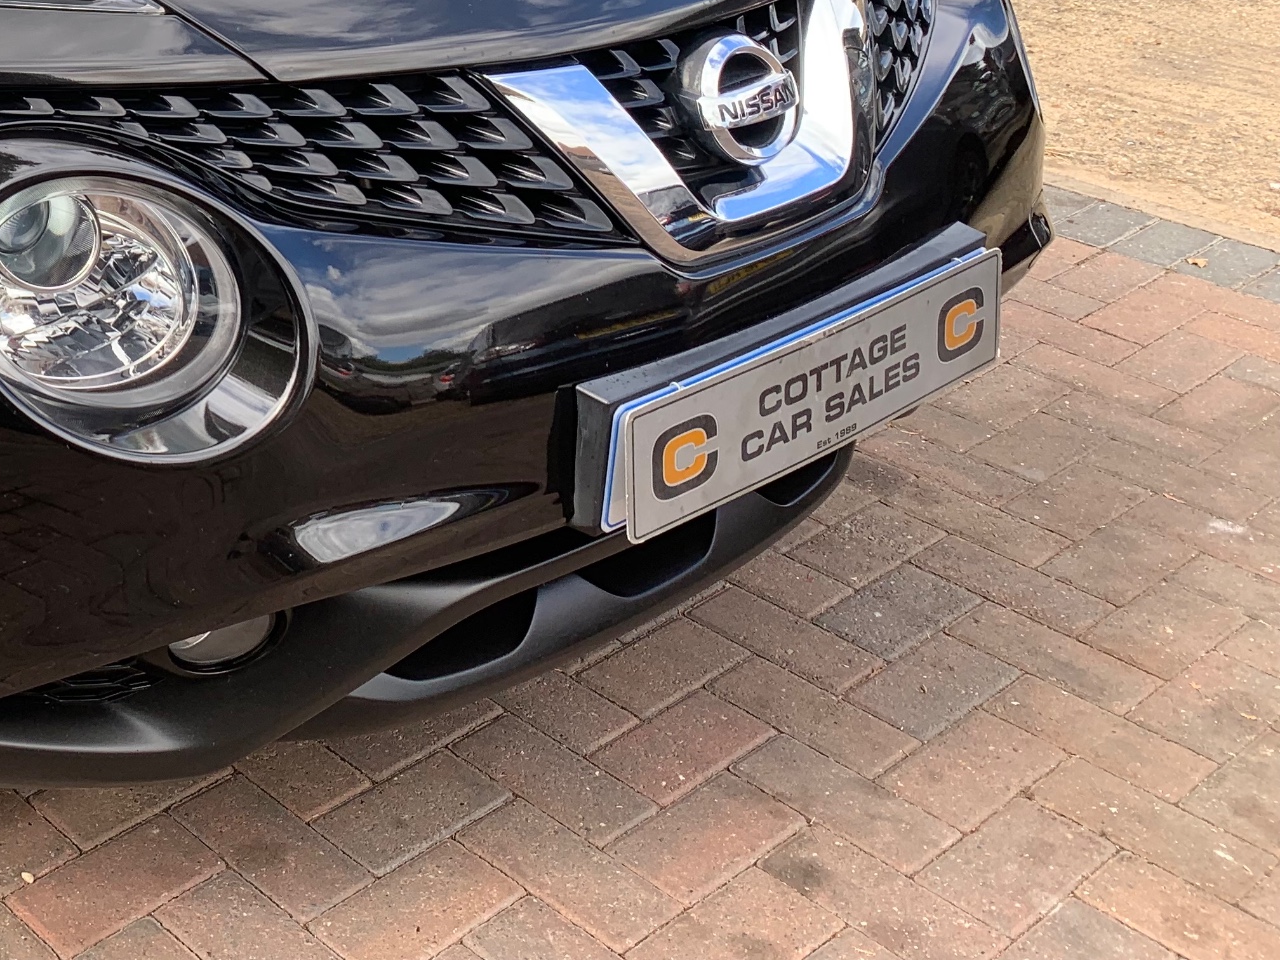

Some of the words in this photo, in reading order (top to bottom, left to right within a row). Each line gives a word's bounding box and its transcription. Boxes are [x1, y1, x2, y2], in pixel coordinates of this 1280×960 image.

[718, 83, 797, 122] NISSAN
[758, 324, 907, 417] COTTAGE
[741, 408, 812, 462] CAR
[825, 352, 920, 423] SALES
[816, 437, 832, 450] Est
